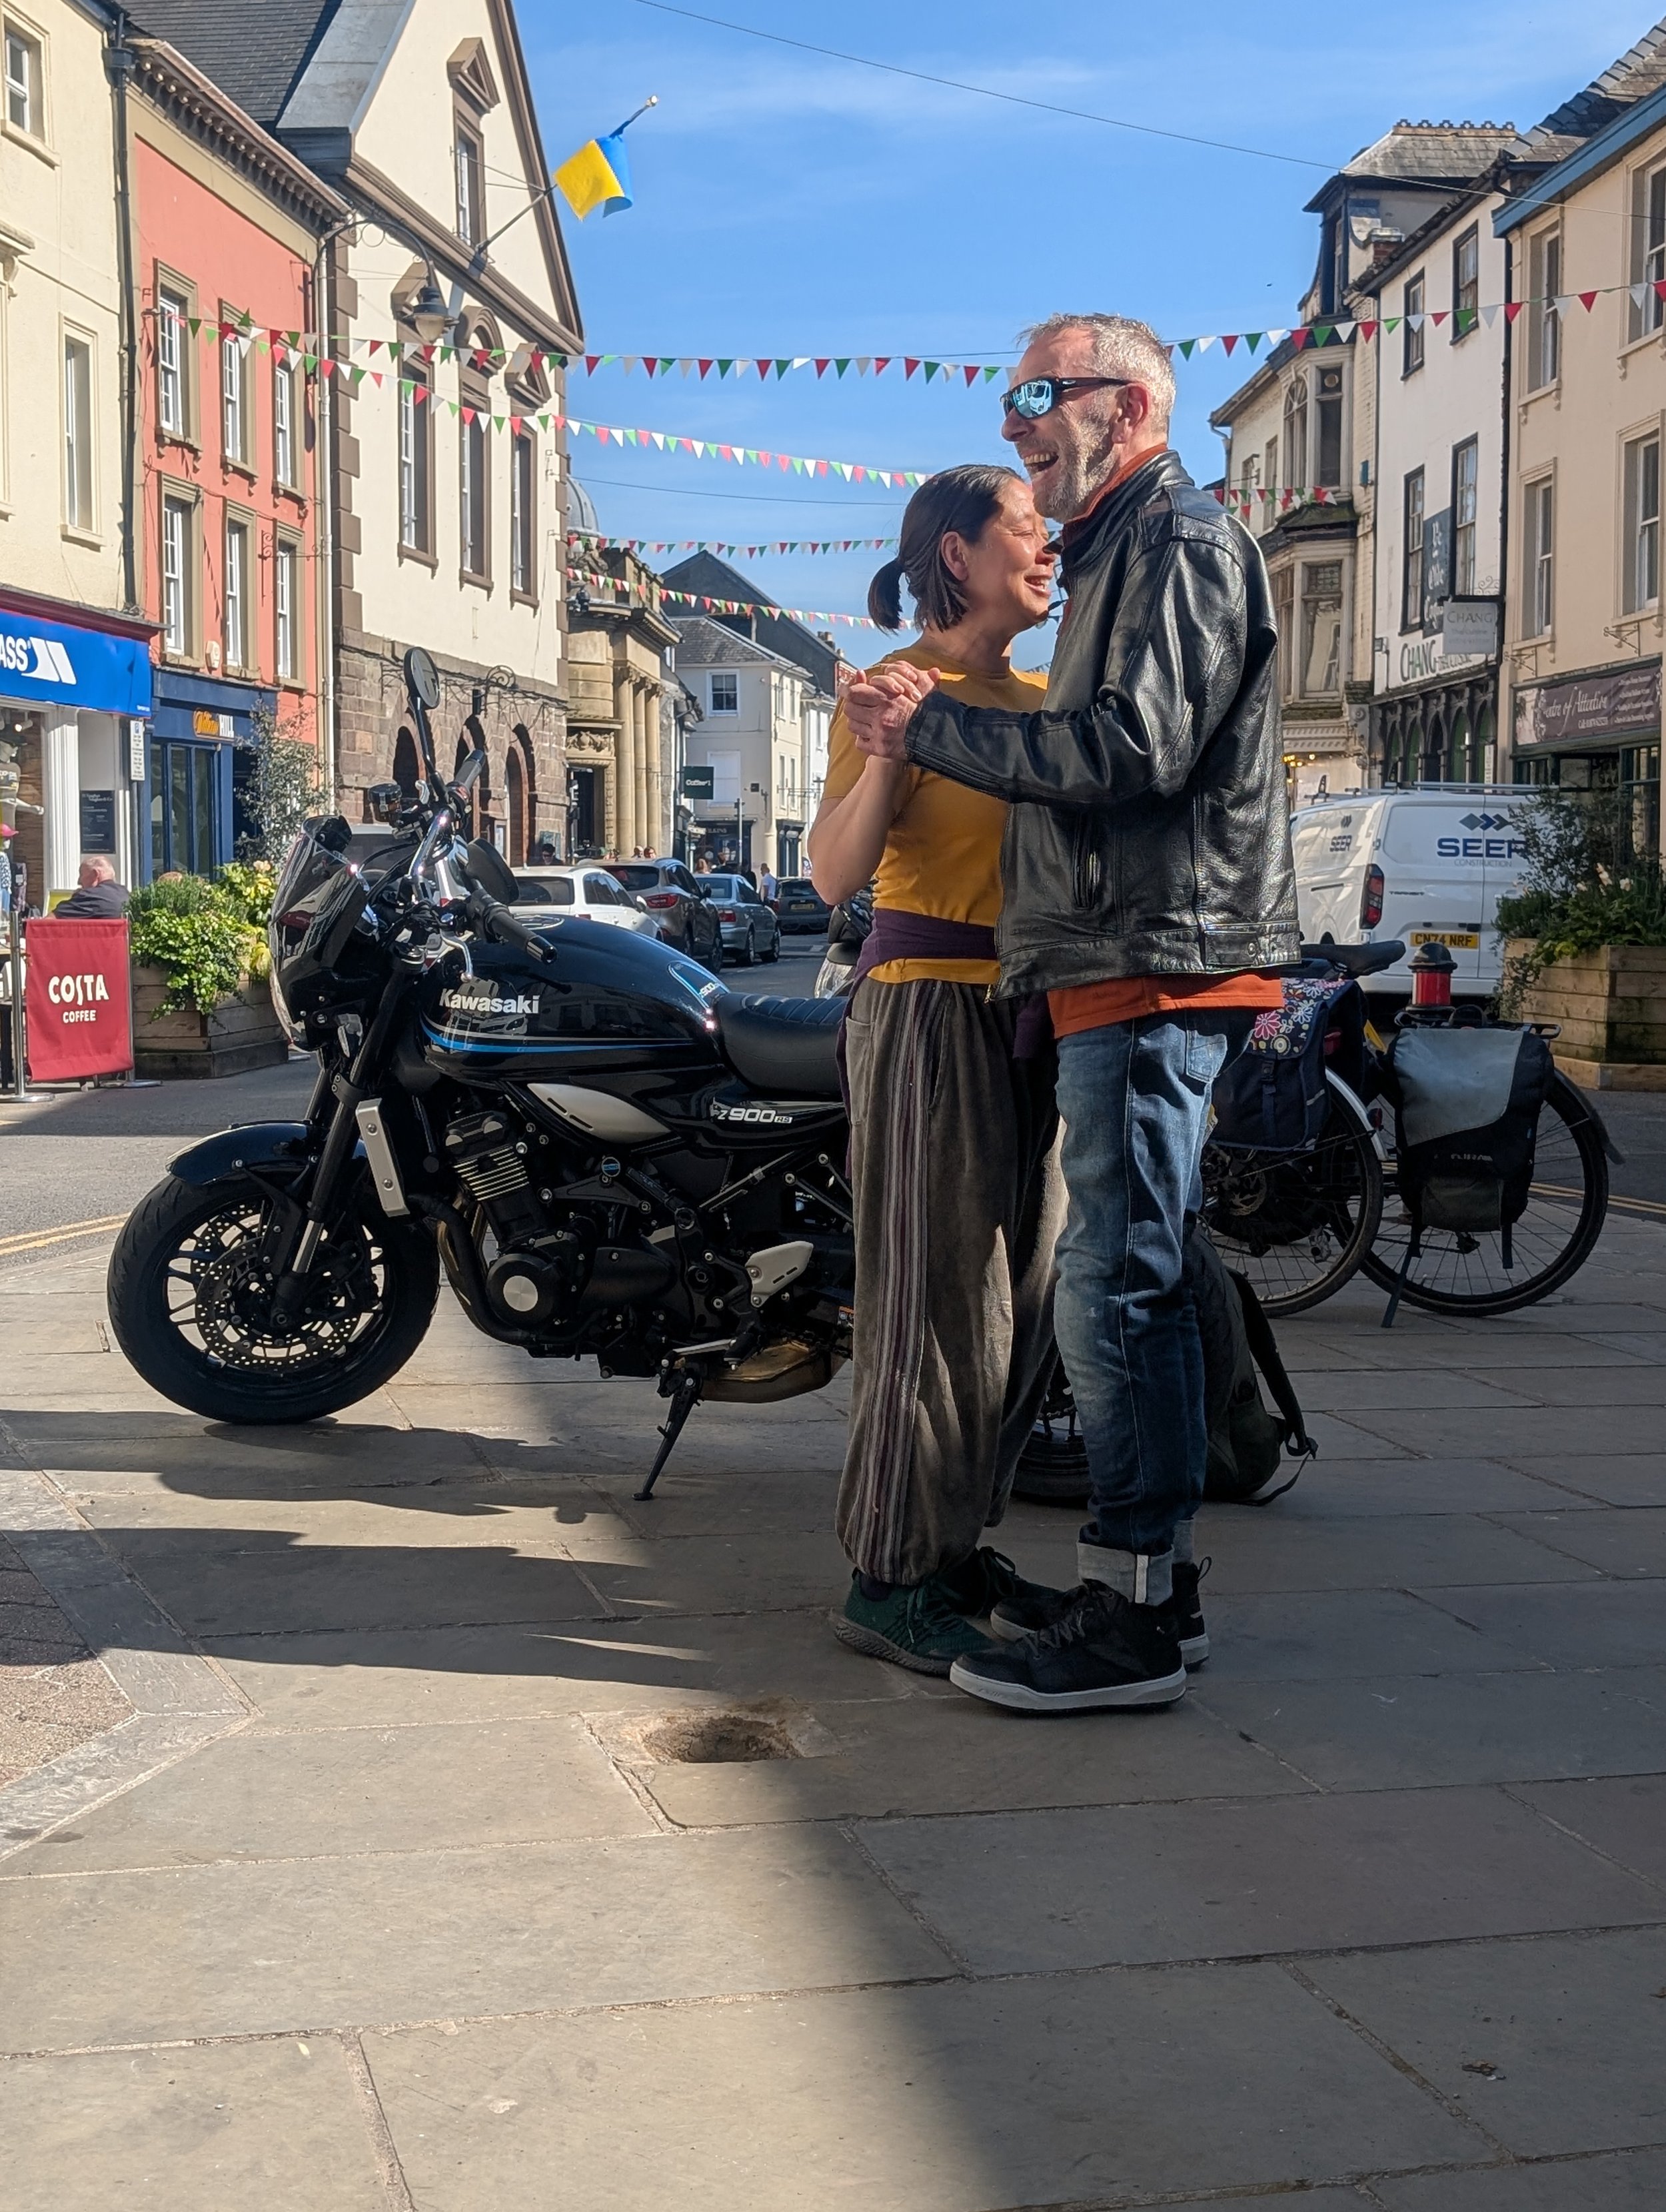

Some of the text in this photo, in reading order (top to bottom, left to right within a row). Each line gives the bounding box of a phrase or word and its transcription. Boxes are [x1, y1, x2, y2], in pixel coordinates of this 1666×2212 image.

[1447, 610, 1493, 624] CHANG
[1400, 640, 1436, 682] CHANG
[1329, 835, 1352, 851] SEER
[1454, 859, 1512, 867] CONSTRUCTION
[1415, 934, 1472, 947] CN74 NRF
[49, 974, 109, 1005] COSTA
[439, 988, 540, 1014] Kawasaki
[63, 1010, 96, 1023] COFFEE
